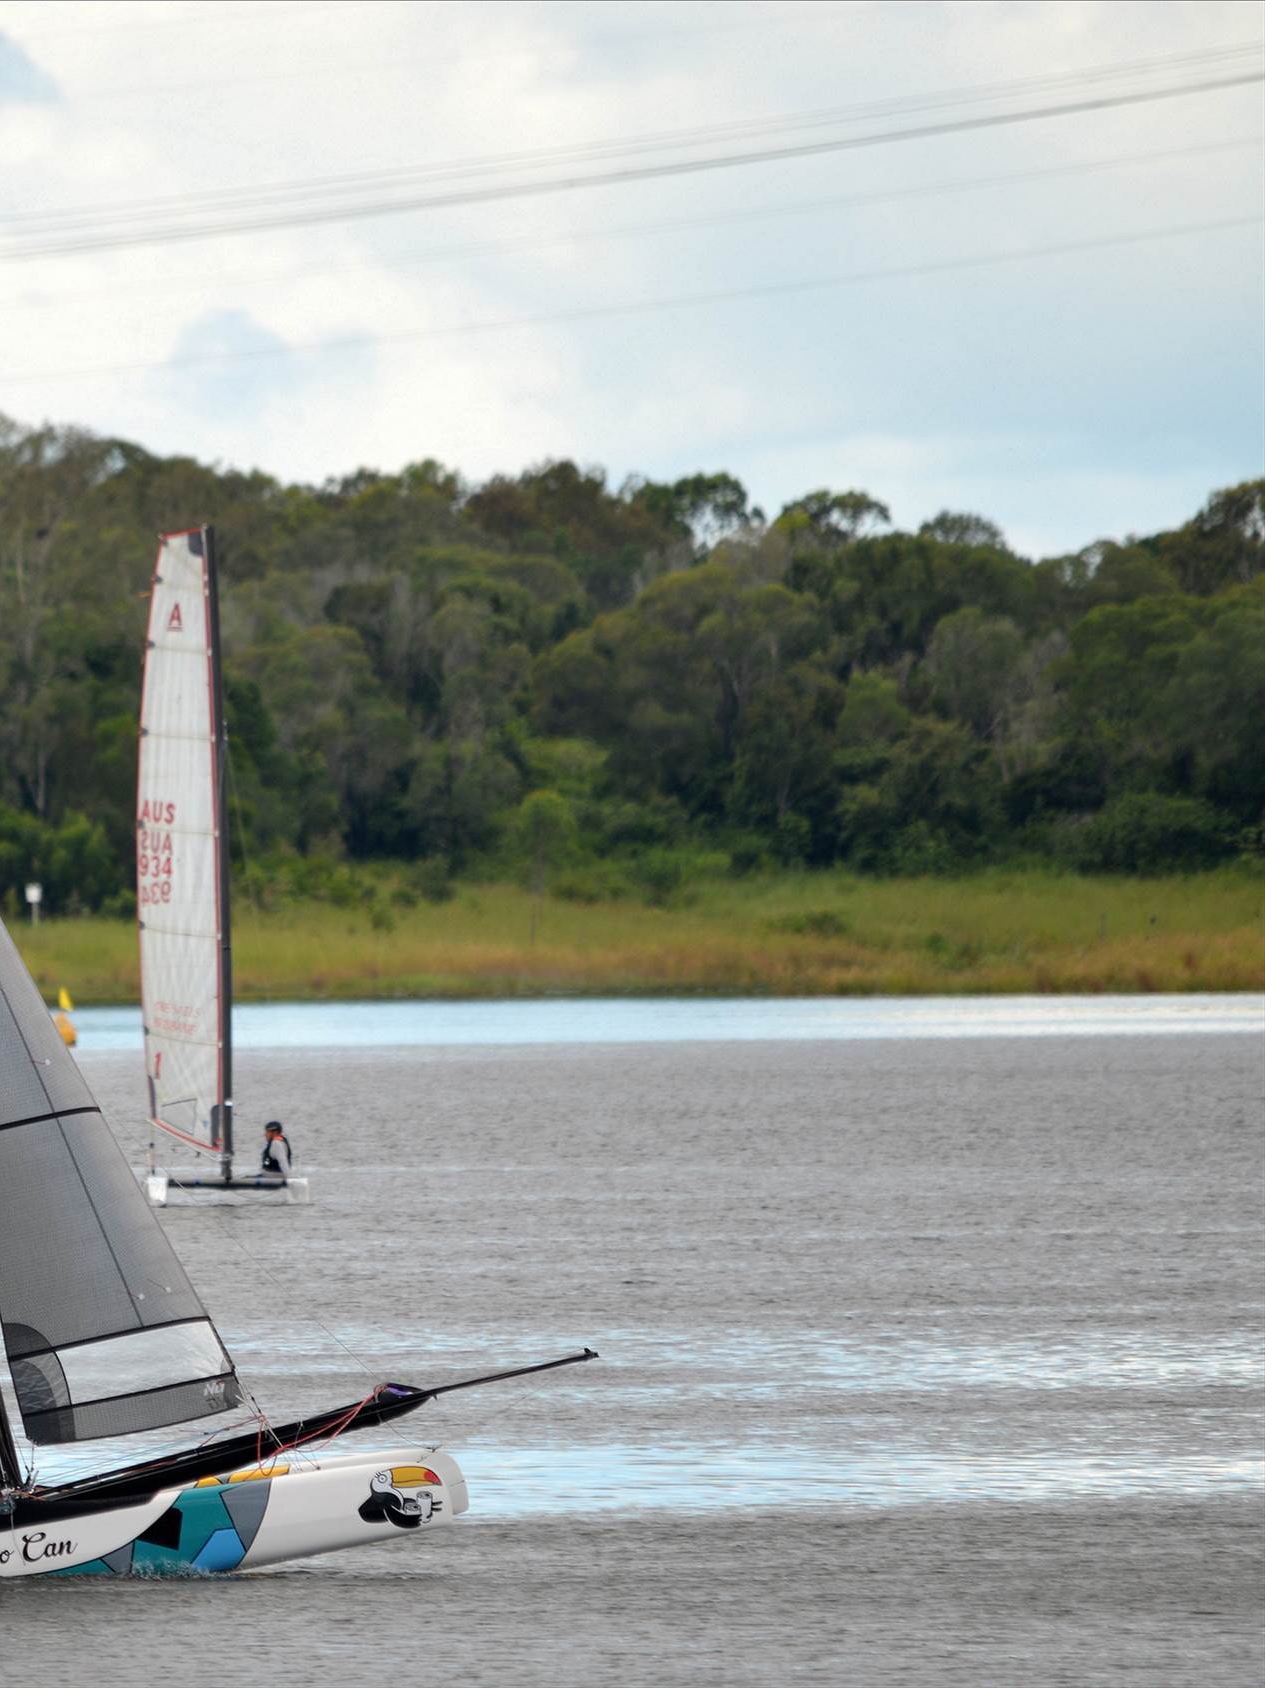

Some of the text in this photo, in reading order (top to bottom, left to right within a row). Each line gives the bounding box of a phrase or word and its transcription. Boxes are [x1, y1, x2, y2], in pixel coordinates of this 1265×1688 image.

[141, 799, 175, 825] AUS
[138, 854, 173, 879] 934
[21, 1532, 78, 1562] Can
